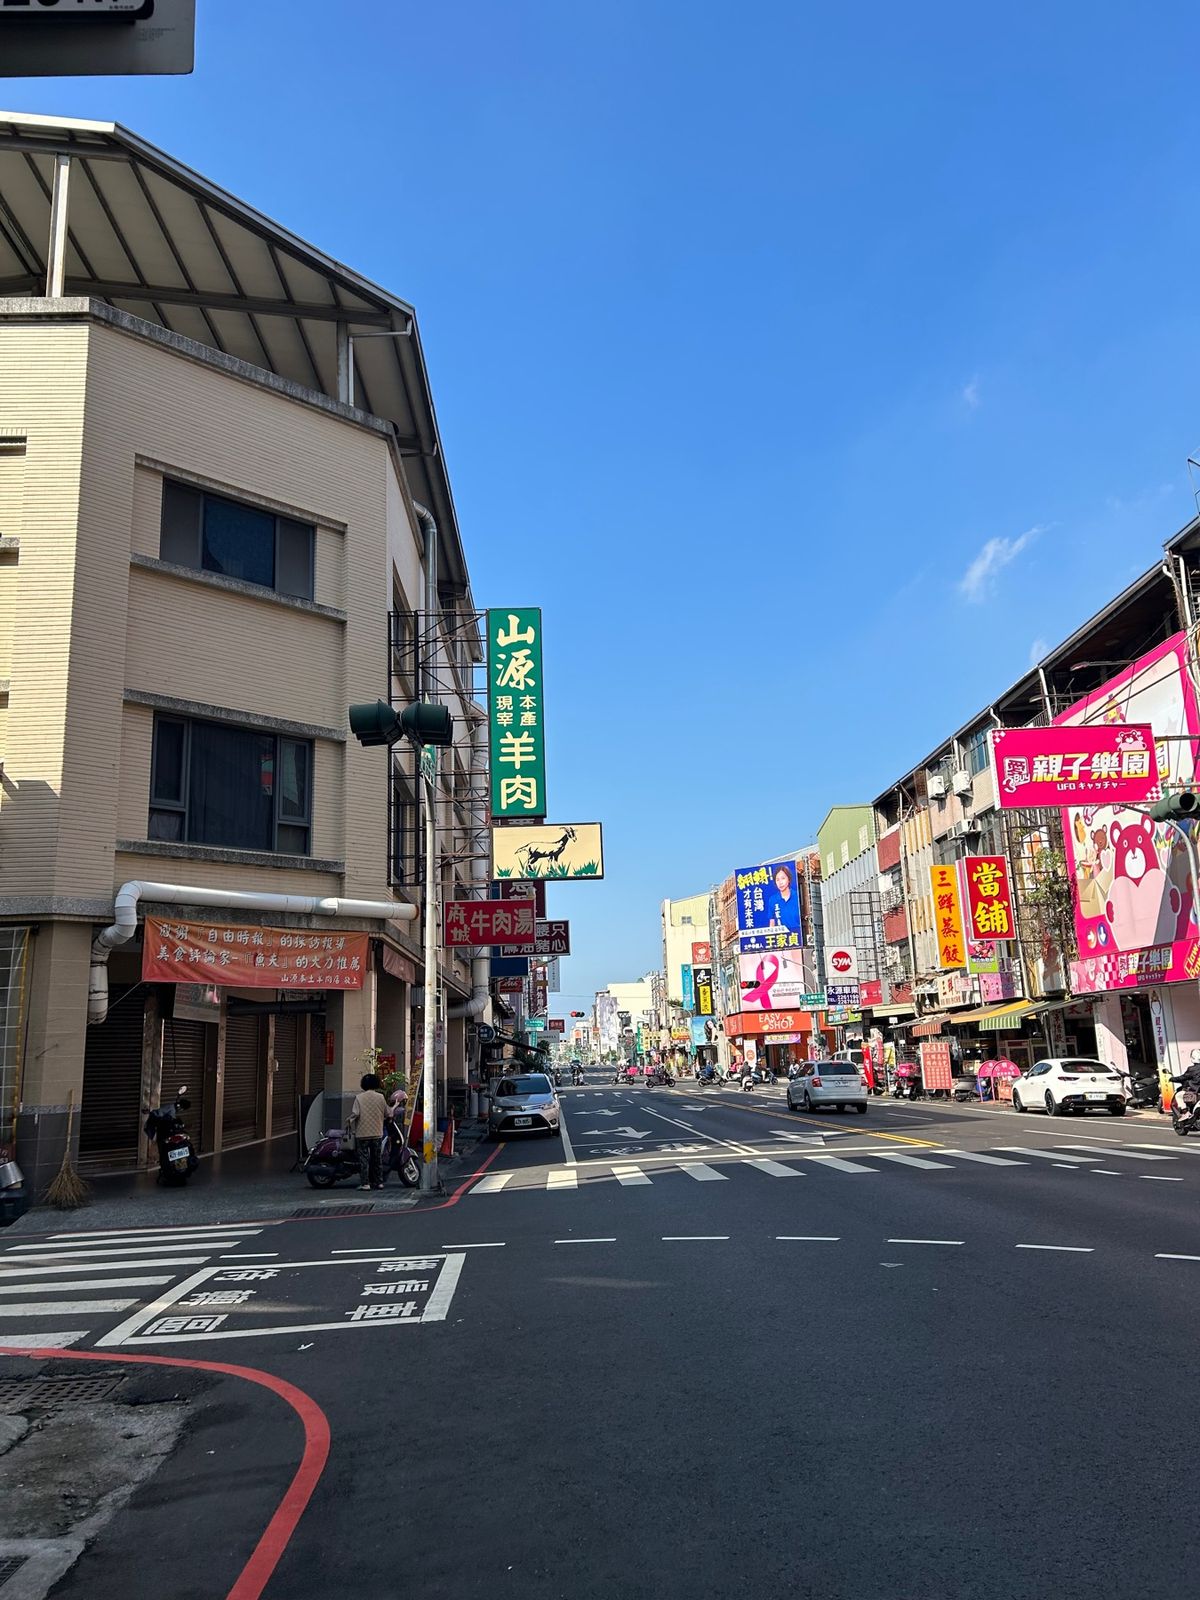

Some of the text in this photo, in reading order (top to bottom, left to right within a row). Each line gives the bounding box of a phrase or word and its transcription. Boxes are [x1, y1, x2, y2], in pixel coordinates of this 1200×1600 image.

[496, 614, 536, 690] 山源
[496, 695, 514, 727] 現宰
[519, 695, 537, 727] 本產
[499, 731, 537, 810] 羊肉
[1031, 751, 1150, 782] 親子樂園
[743, 888, 755, 929] 才有未來
[753, 886, 765, 912] 台灣
[447, 904, 472, 944] 府城
[470, 908, 533, 937] 牛肉湯
[936, 870, 963, 964] 三鮮蒸餃
[764, 931, 800, 949] 王家貞
[832, 958, 852, 966] SYM
[1128, 946, 1173, 975] 親子樂園
[758, 1013, 780, 1023] EASY
[768, 1017, 794, 1030] SHOP
